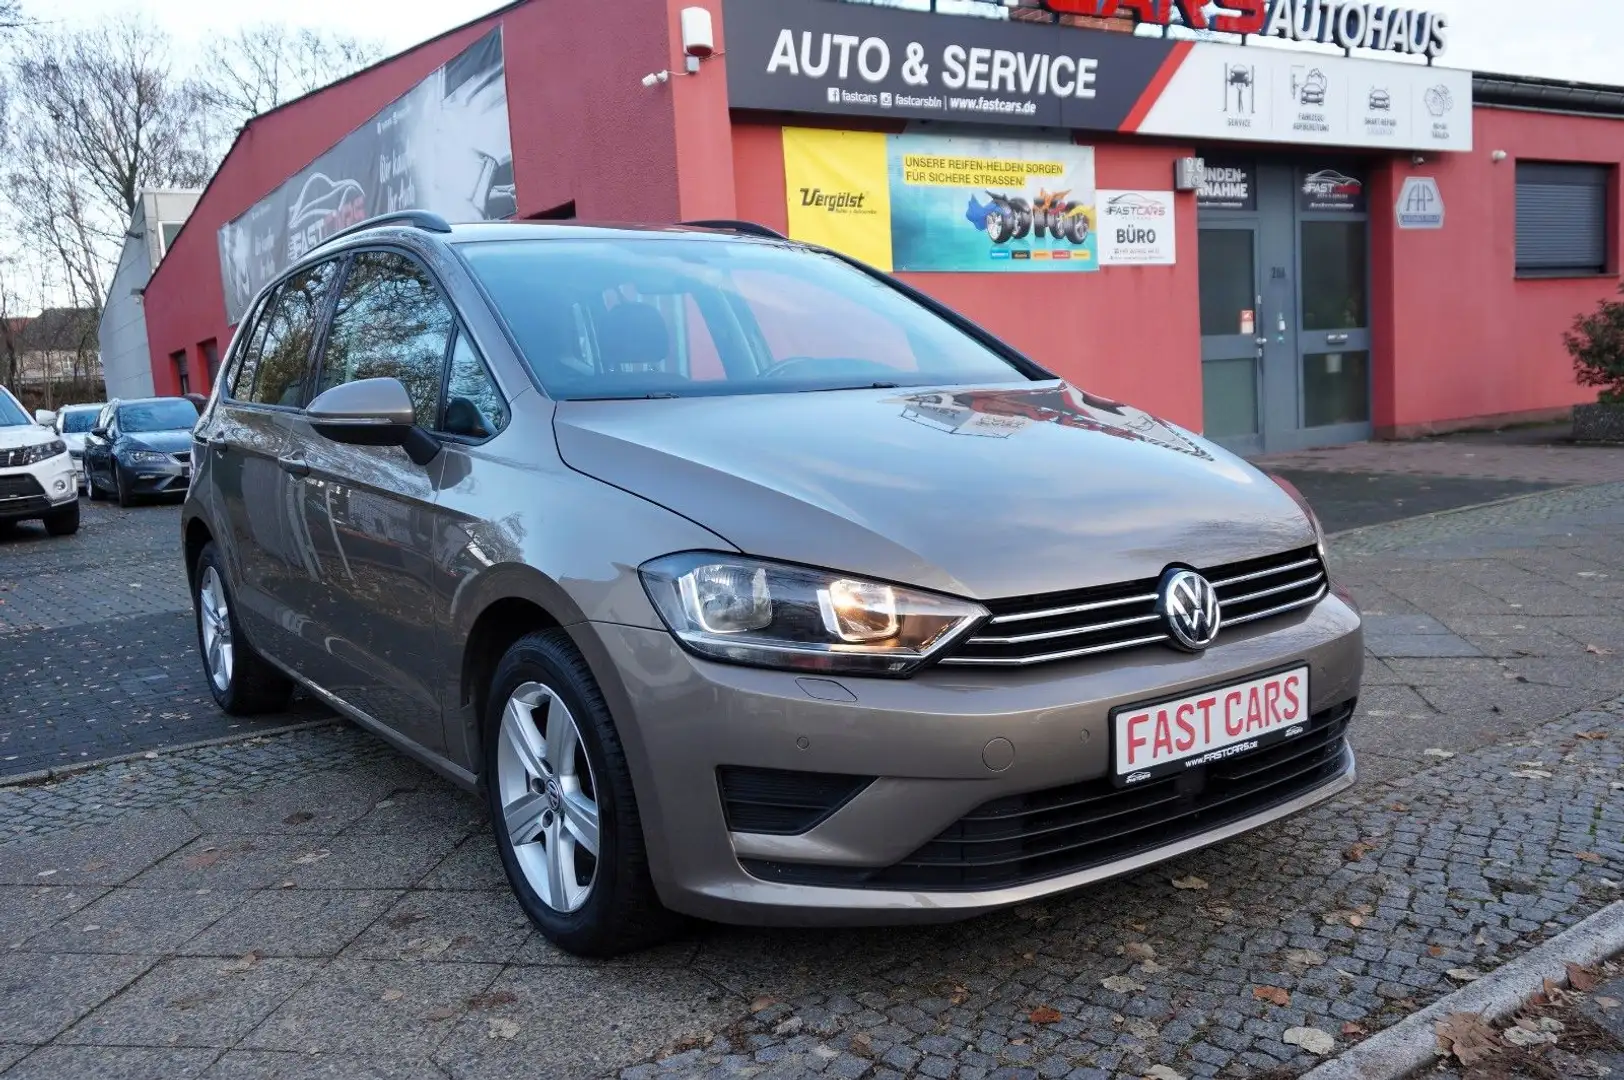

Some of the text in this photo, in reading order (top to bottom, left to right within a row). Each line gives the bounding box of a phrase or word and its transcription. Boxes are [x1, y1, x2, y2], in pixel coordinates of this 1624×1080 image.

[1266, 0, 1448, 57] AUTOHAUS
[767, 28, 1099, 98] AUTO & SERVICE
[842, 90, 878, 104] fastcars
[950, 96, 1037, 114] www.fastcars.de
[905, 157, 1063, 174] UNSERE REIFEN-HELDEN SORGEN
[1203, 166, 1247, 182] UNDEN-
[929, 173, 971, 184] SICHERE
[800, 187, 865, 211] Vergölst
[1196, 182, 1249, 198] NNAHME
[1117, 224, 1156, 243] BÜRO
[1127, 675, 1300, 765] FAST CARS
